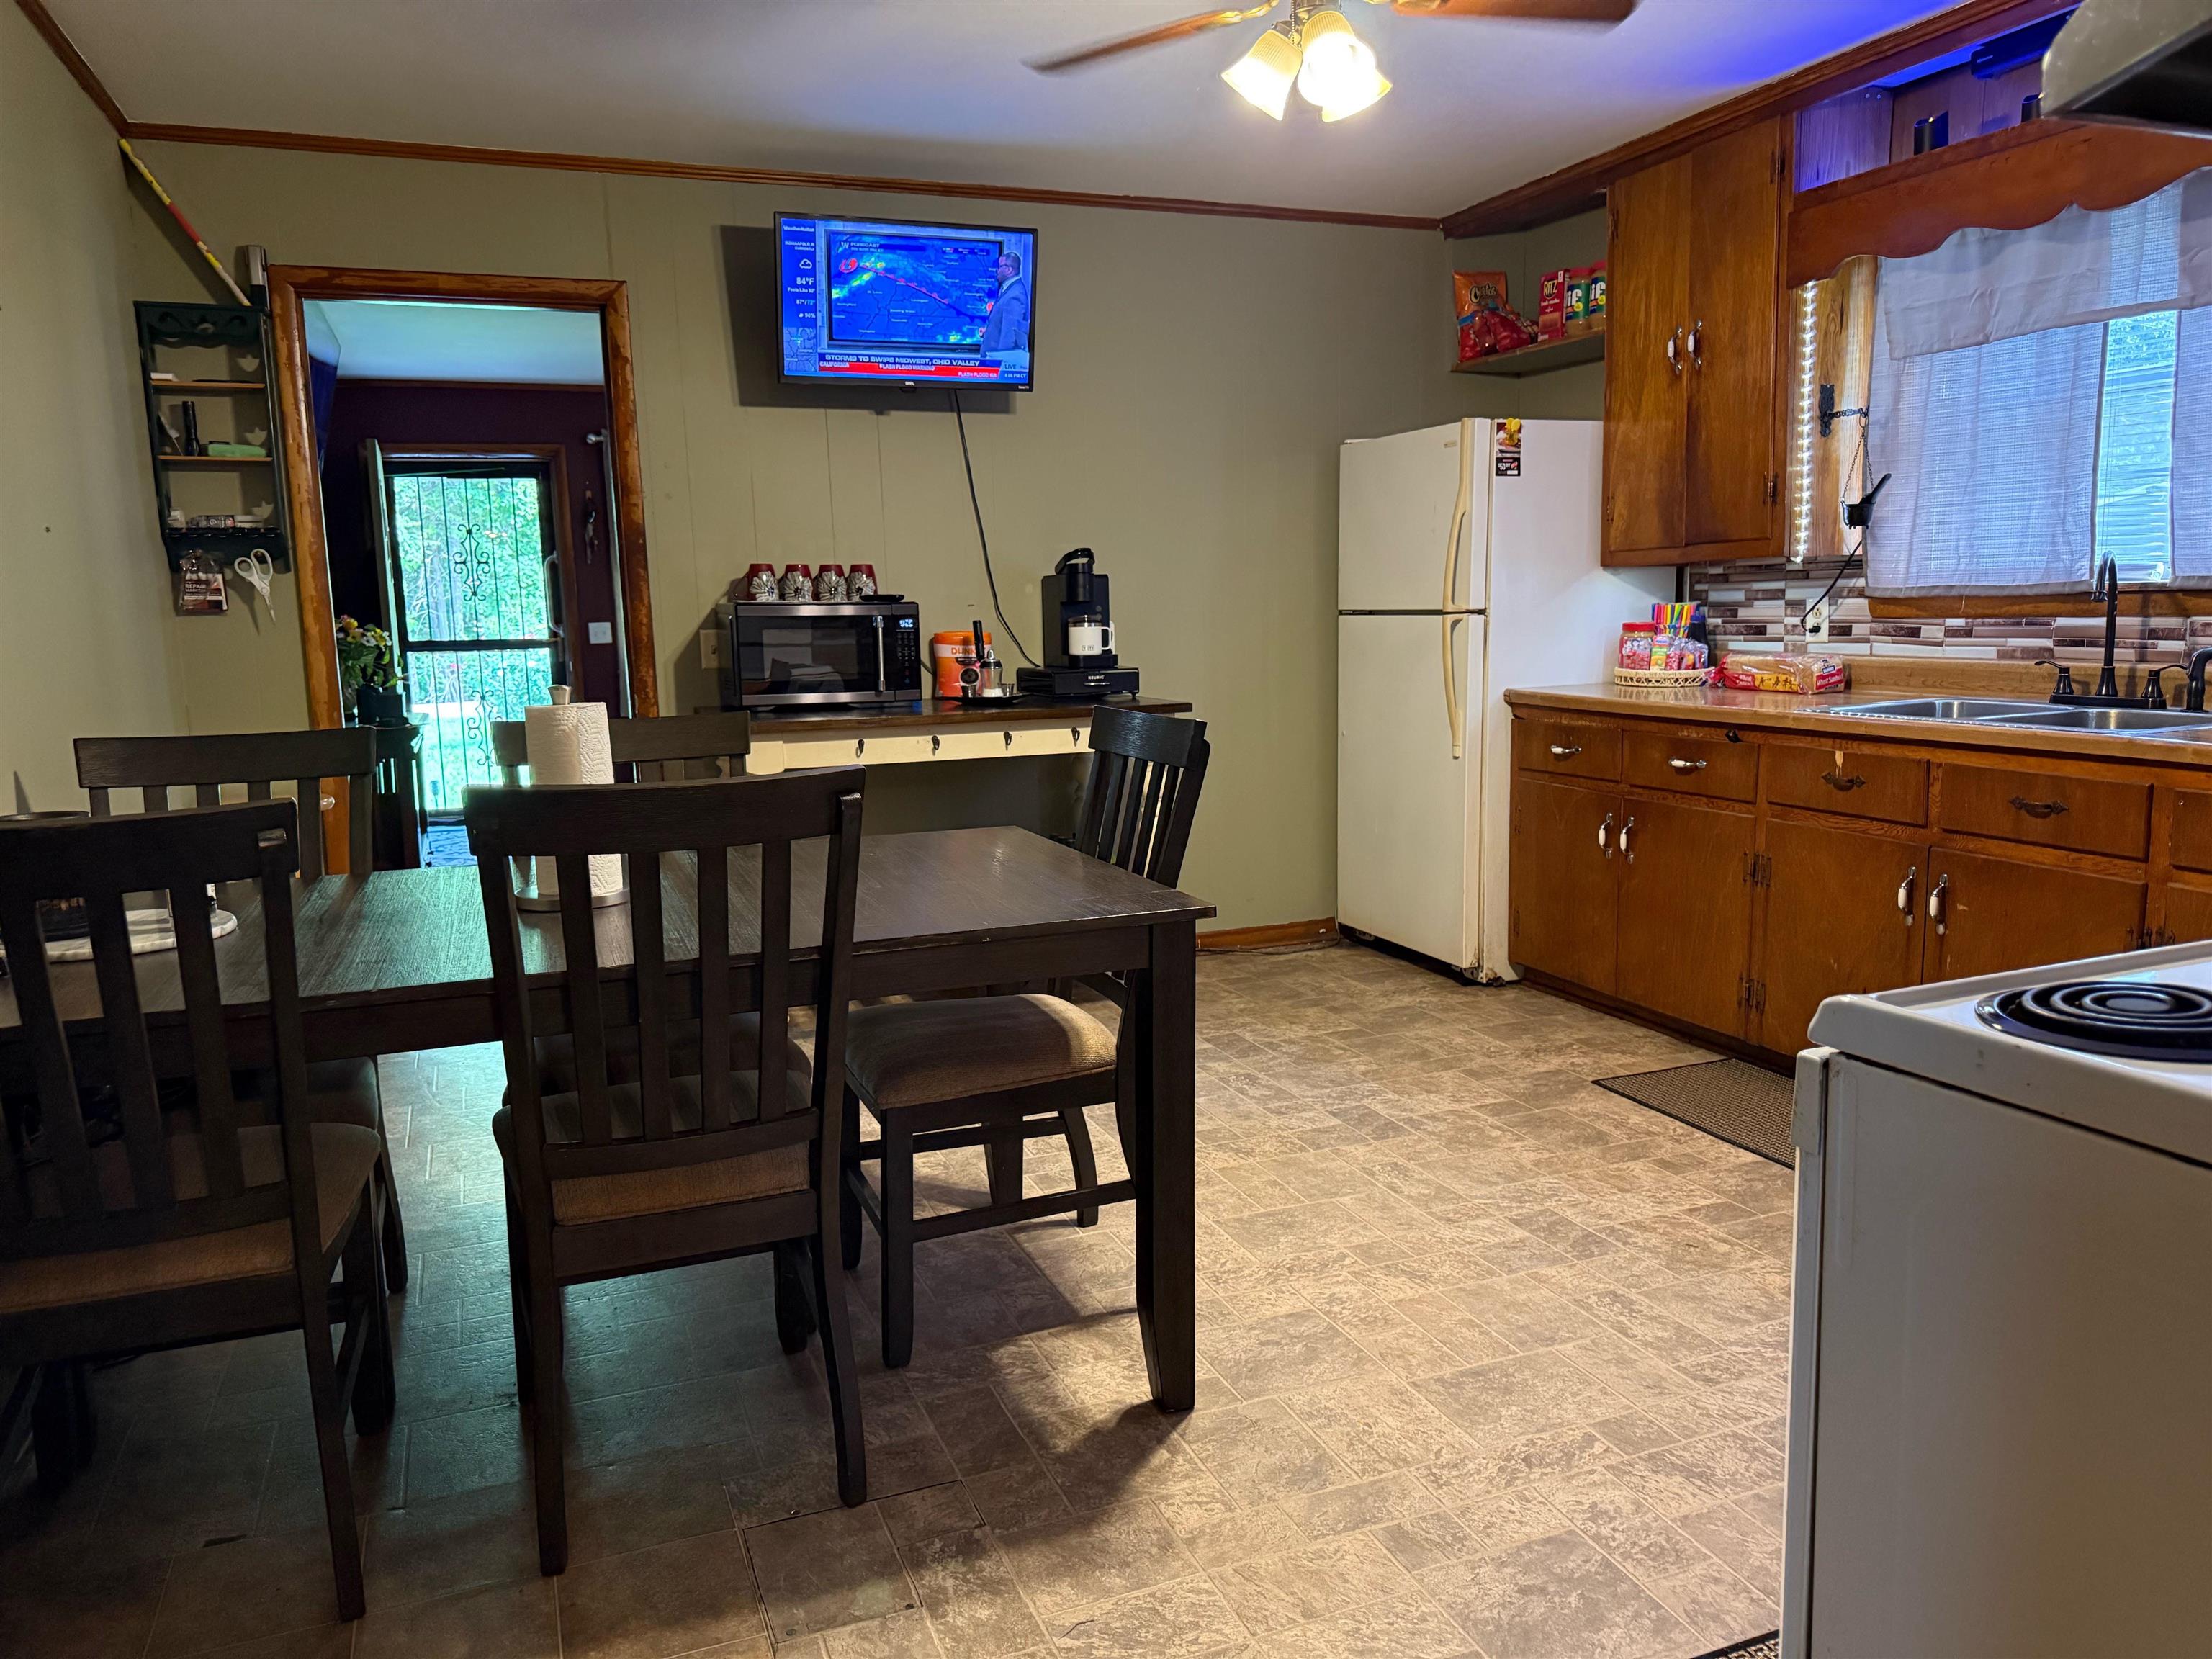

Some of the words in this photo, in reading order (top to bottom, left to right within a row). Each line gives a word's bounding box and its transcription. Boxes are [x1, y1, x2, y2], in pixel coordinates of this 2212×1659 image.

[796, 276, 815, 285] 84°F
[1543, 279, 1558, 296] RITZ
[1567, 289, 1583, 307] if
[1591, 282, 1606, 300] if
